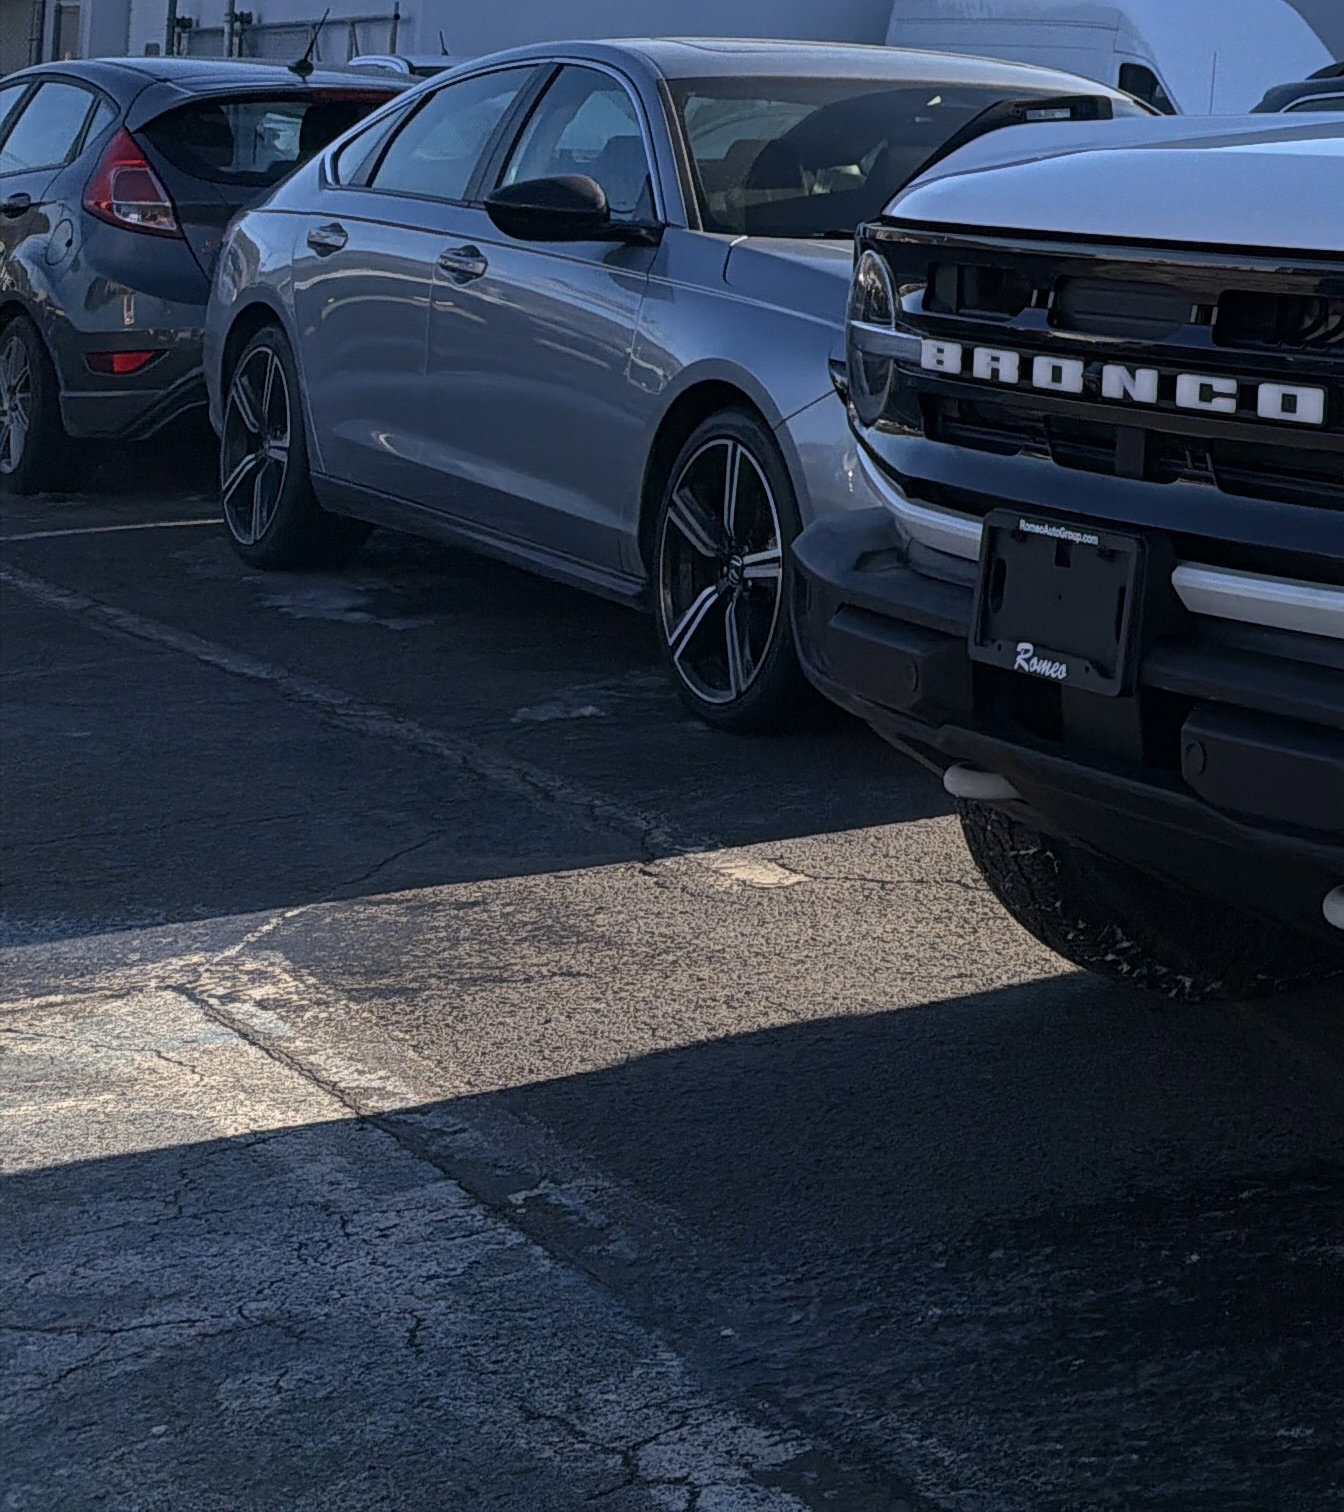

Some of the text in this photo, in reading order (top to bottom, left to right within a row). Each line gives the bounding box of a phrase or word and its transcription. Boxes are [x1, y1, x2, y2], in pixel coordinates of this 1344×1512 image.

[921, 339, 1324, 425] BRONCO
[1019, 519, 1099, 546] RomeoAutoGroup.com
[1014, 643, 1067, 680] Romeo
